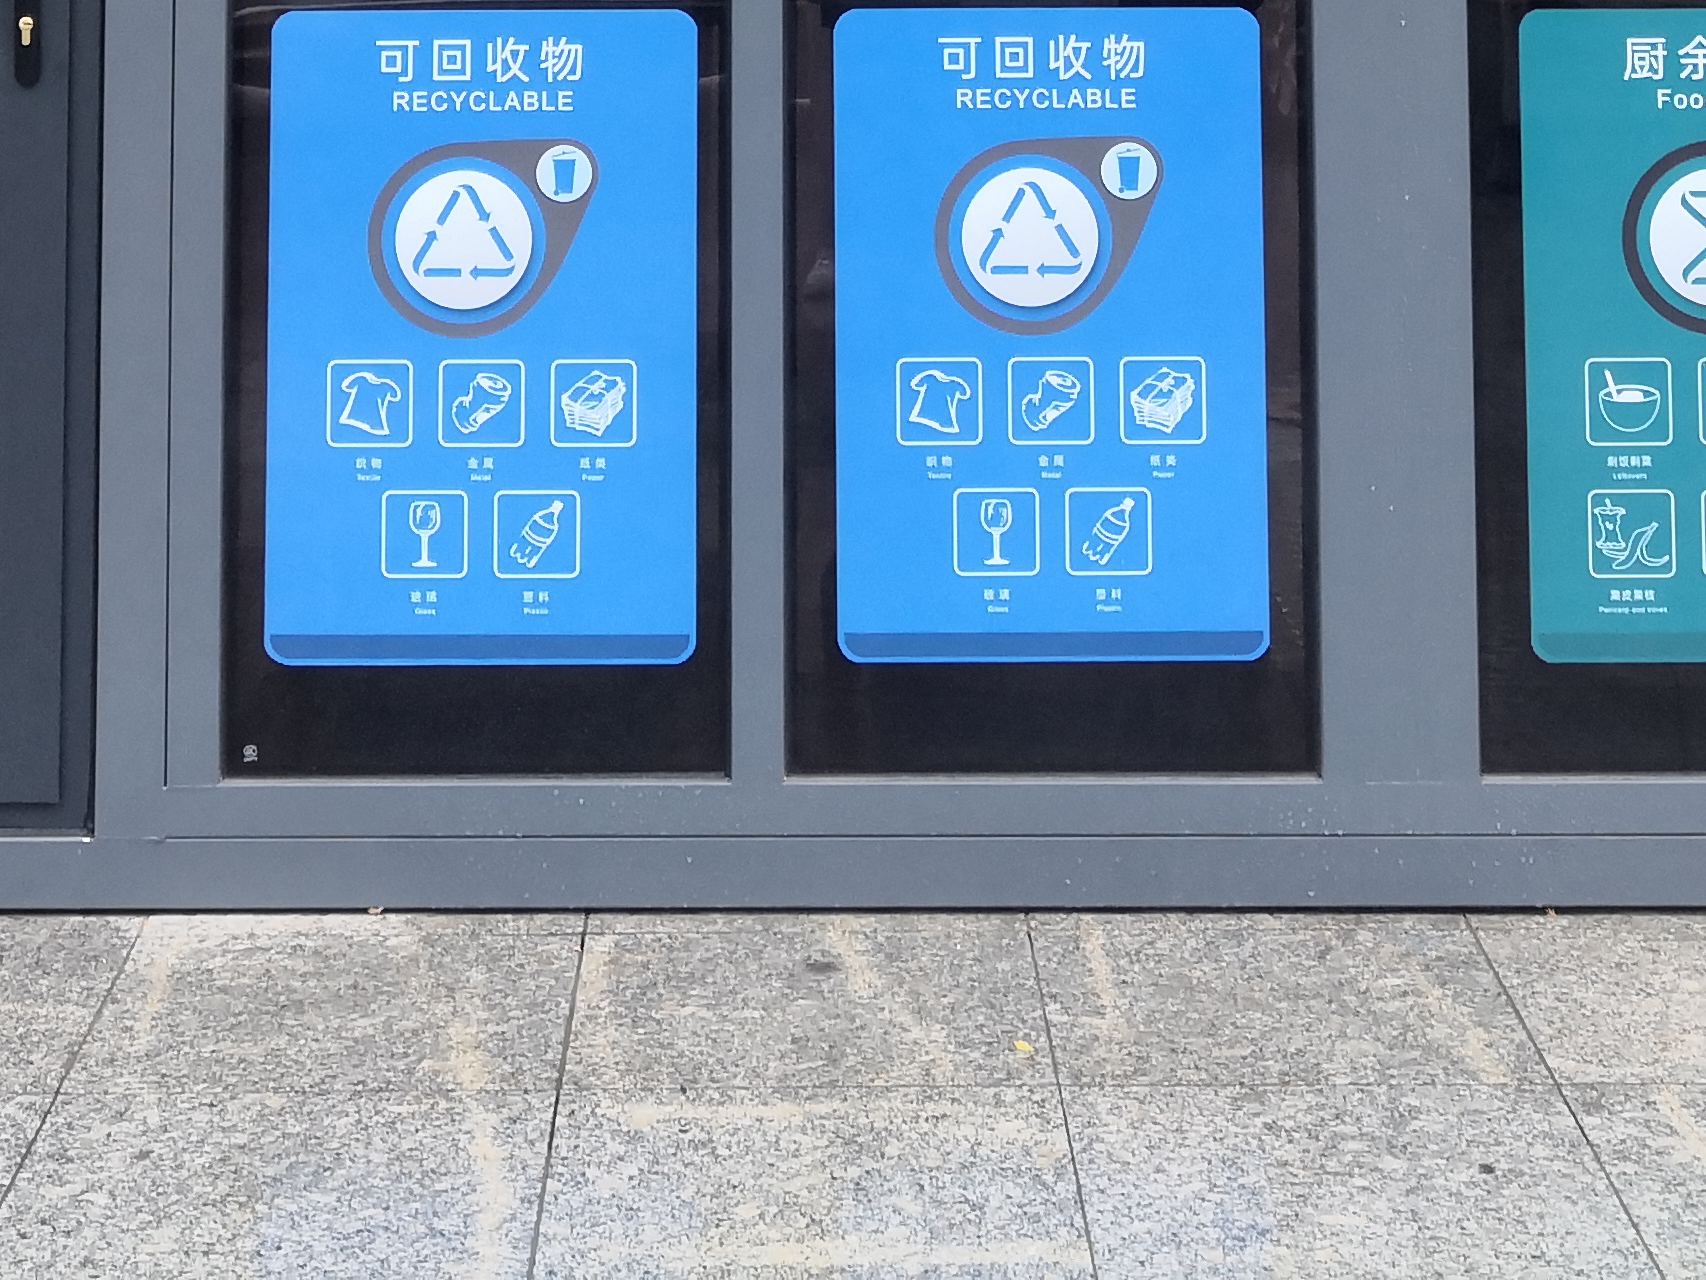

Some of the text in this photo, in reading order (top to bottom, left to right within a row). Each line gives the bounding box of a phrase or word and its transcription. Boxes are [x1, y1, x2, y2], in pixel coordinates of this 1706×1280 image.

[375, 36, 583, 83] 可回收物
[937, 34, 1145, 80] 可回收物
[393, 90, 573, 112] RECYCLABLE
[956, 88, 1136, 109] RECYCLABLE
